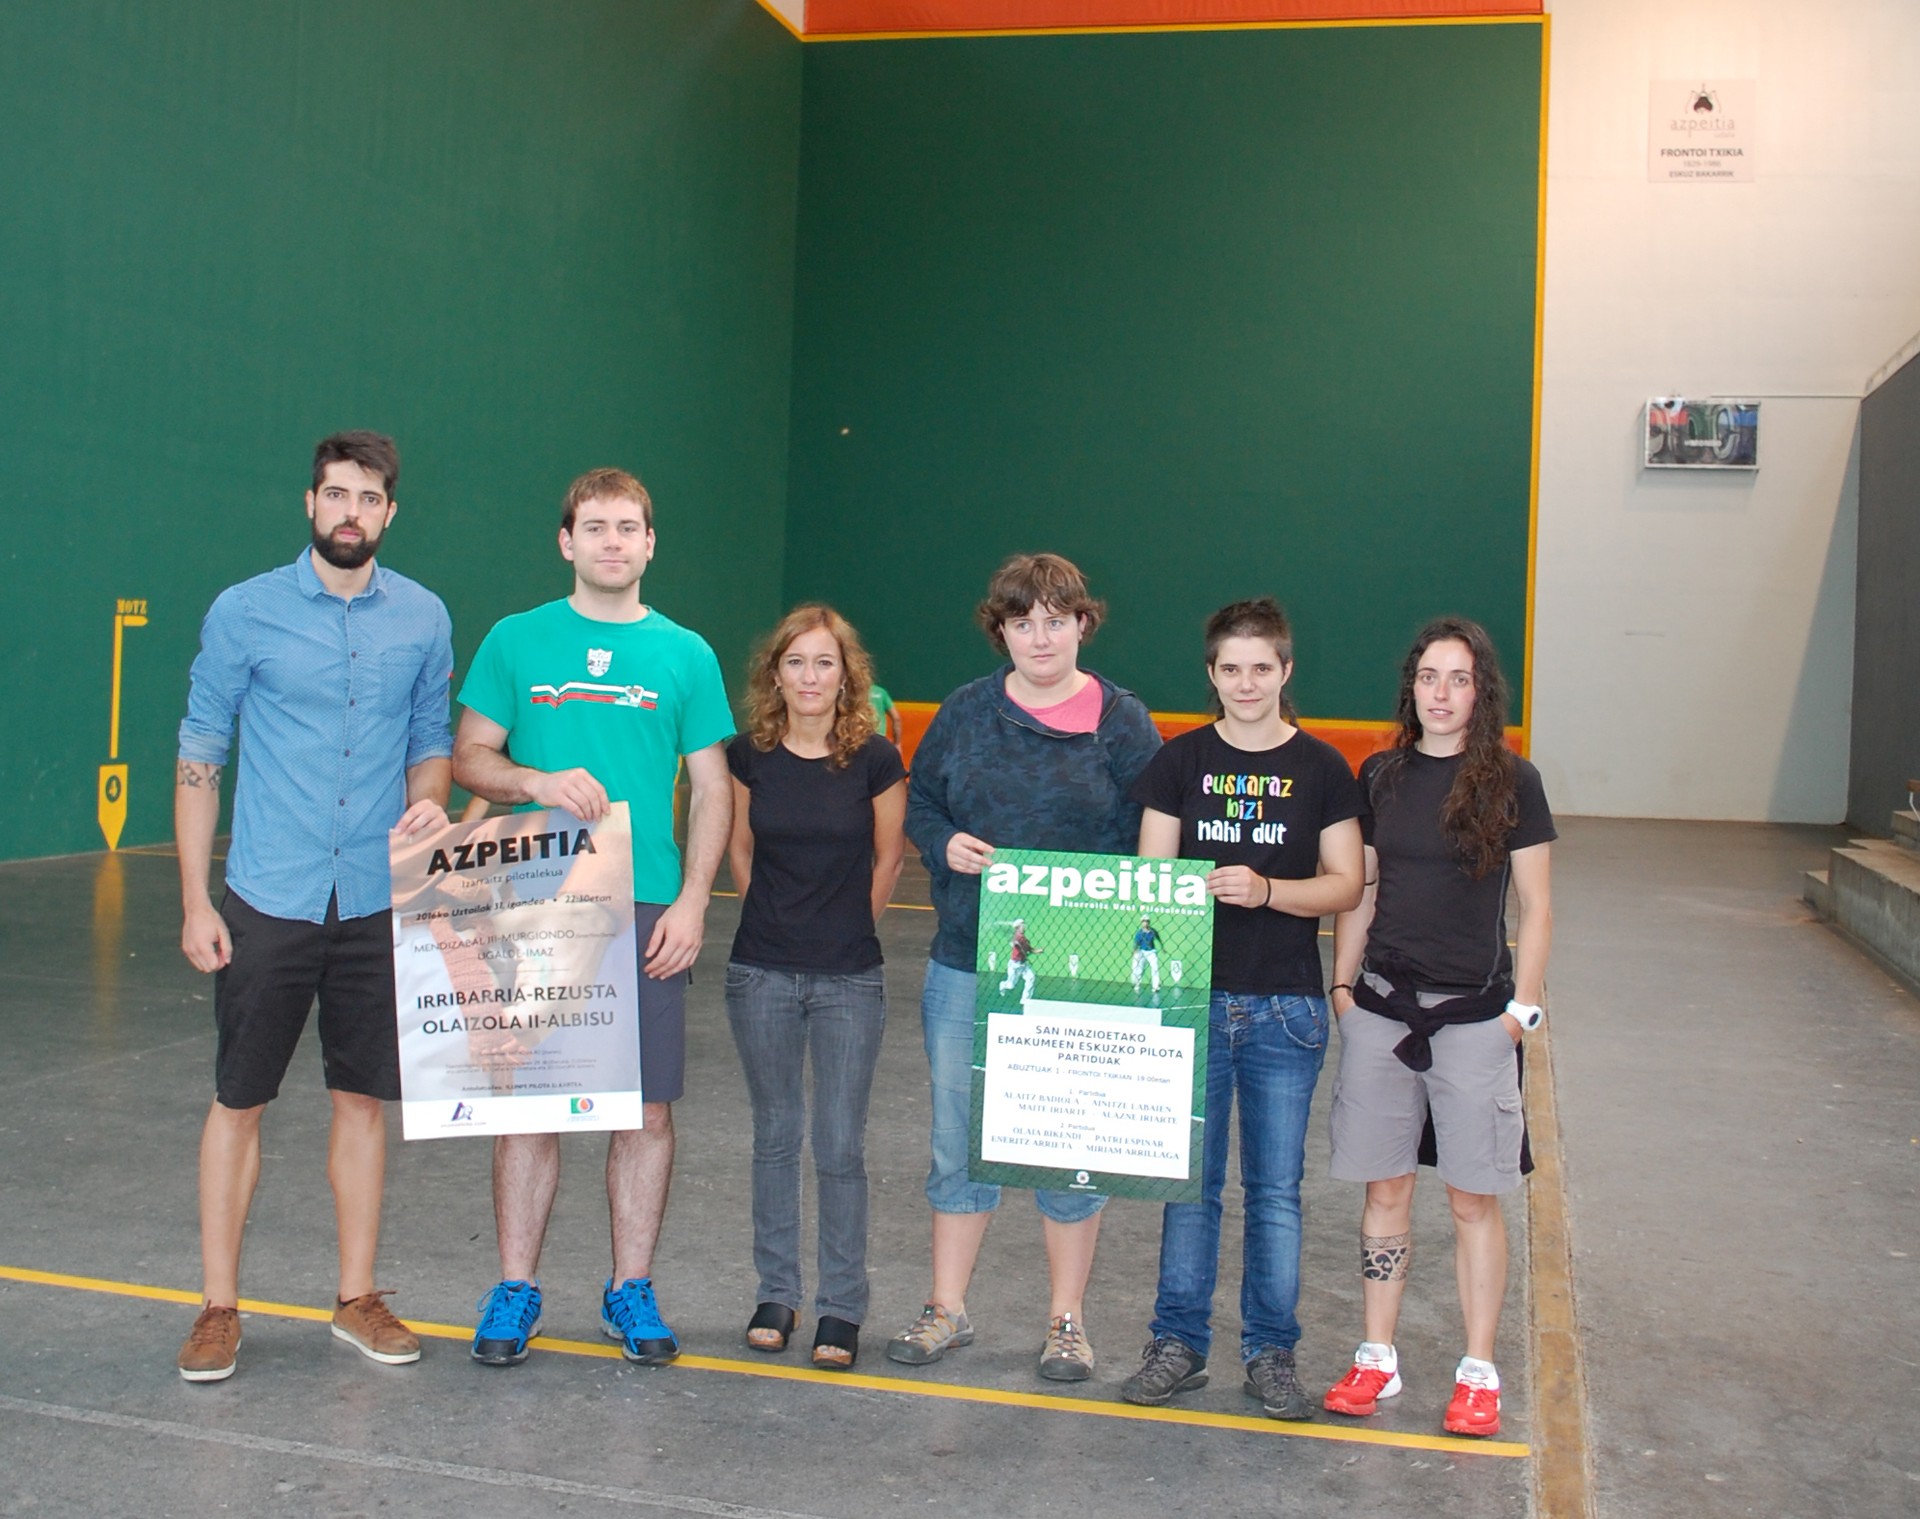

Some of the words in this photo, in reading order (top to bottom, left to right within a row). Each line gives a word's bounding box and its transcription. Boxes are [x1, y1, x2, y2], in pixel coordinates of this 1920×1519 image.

[1670, 116, 1735, 138] azpeitia
[1660, 148, 1707, 157] FRONTOI
[1709, 148, 1744, 157] TXIKIA
[1203, 774, 1293, 797] euskaraz
[1226, 798, 1263, 820] bizi
[1198, 820, 1241, 843] nahi
[1252, 822, 1287, 845] dut
[427, 828, 597, 875] AZPEITIA
[462, 876, 502, 888] Izarraitz
[505, 868, 563, 883] pilotalekua
[986, 860, 1206, 907] azpeitia
[416, 909, 449, 921] 2016ko
[452, 904, 492, 917] Uztailak
[506, 898, 545, 911] igandea
[414, 937, 486, 953] MENDIZABAL
[477, 947, 555, 961] UGALDE-IMAZ
[417, 984, 617, 1009] IRRIBARRIA-REZUSTA
[423, 1015, 522, 1034] OLAIZOLA
[528, 1011, 614, 1029] II-ALBISU
[1036, 1025, 1060, 1035] SAN
[1064, 1028, 1146, 1043] INAZIOETAKO
[998, 1035, 1074, 1049] EMAKUMEEN
[1079, 1042, 1136, 1055] ESKUZKO
[1140, 1047, 1184, 1059] PILOTA
[1058, 1053, 1121, 1065] PARTIDUAK
[1007, 1063, 1052, 1073] ABUZTUAK
[1068, 1069, 1101, 1078] FRONTOI
[1004, 1092, 1037, 1102] ALAITZ
[1039, 1094, 1080, 1105] BADIOLA
[1018, 1103, 1047, 1112] MAITE
[1050, 1106, 1086, 1116] IRIARTE
[1102, 1111, 1137, 1121] ALAZNE
[1140, 1114, 1177, 1124] IRIARTE
[991, 1135, 1030, 1145] ENERITZ
[1033, 1139, 1073, 1150] ARRIETA
[1086, 1144, 1122, 1155] MIRIAM
[1125, 1148, 1180, 1160] ARRILLAGA
[1095, 1134, 1122, 1144] PATRI
[1125, 1138, 1164, 1148] ESPINAR
